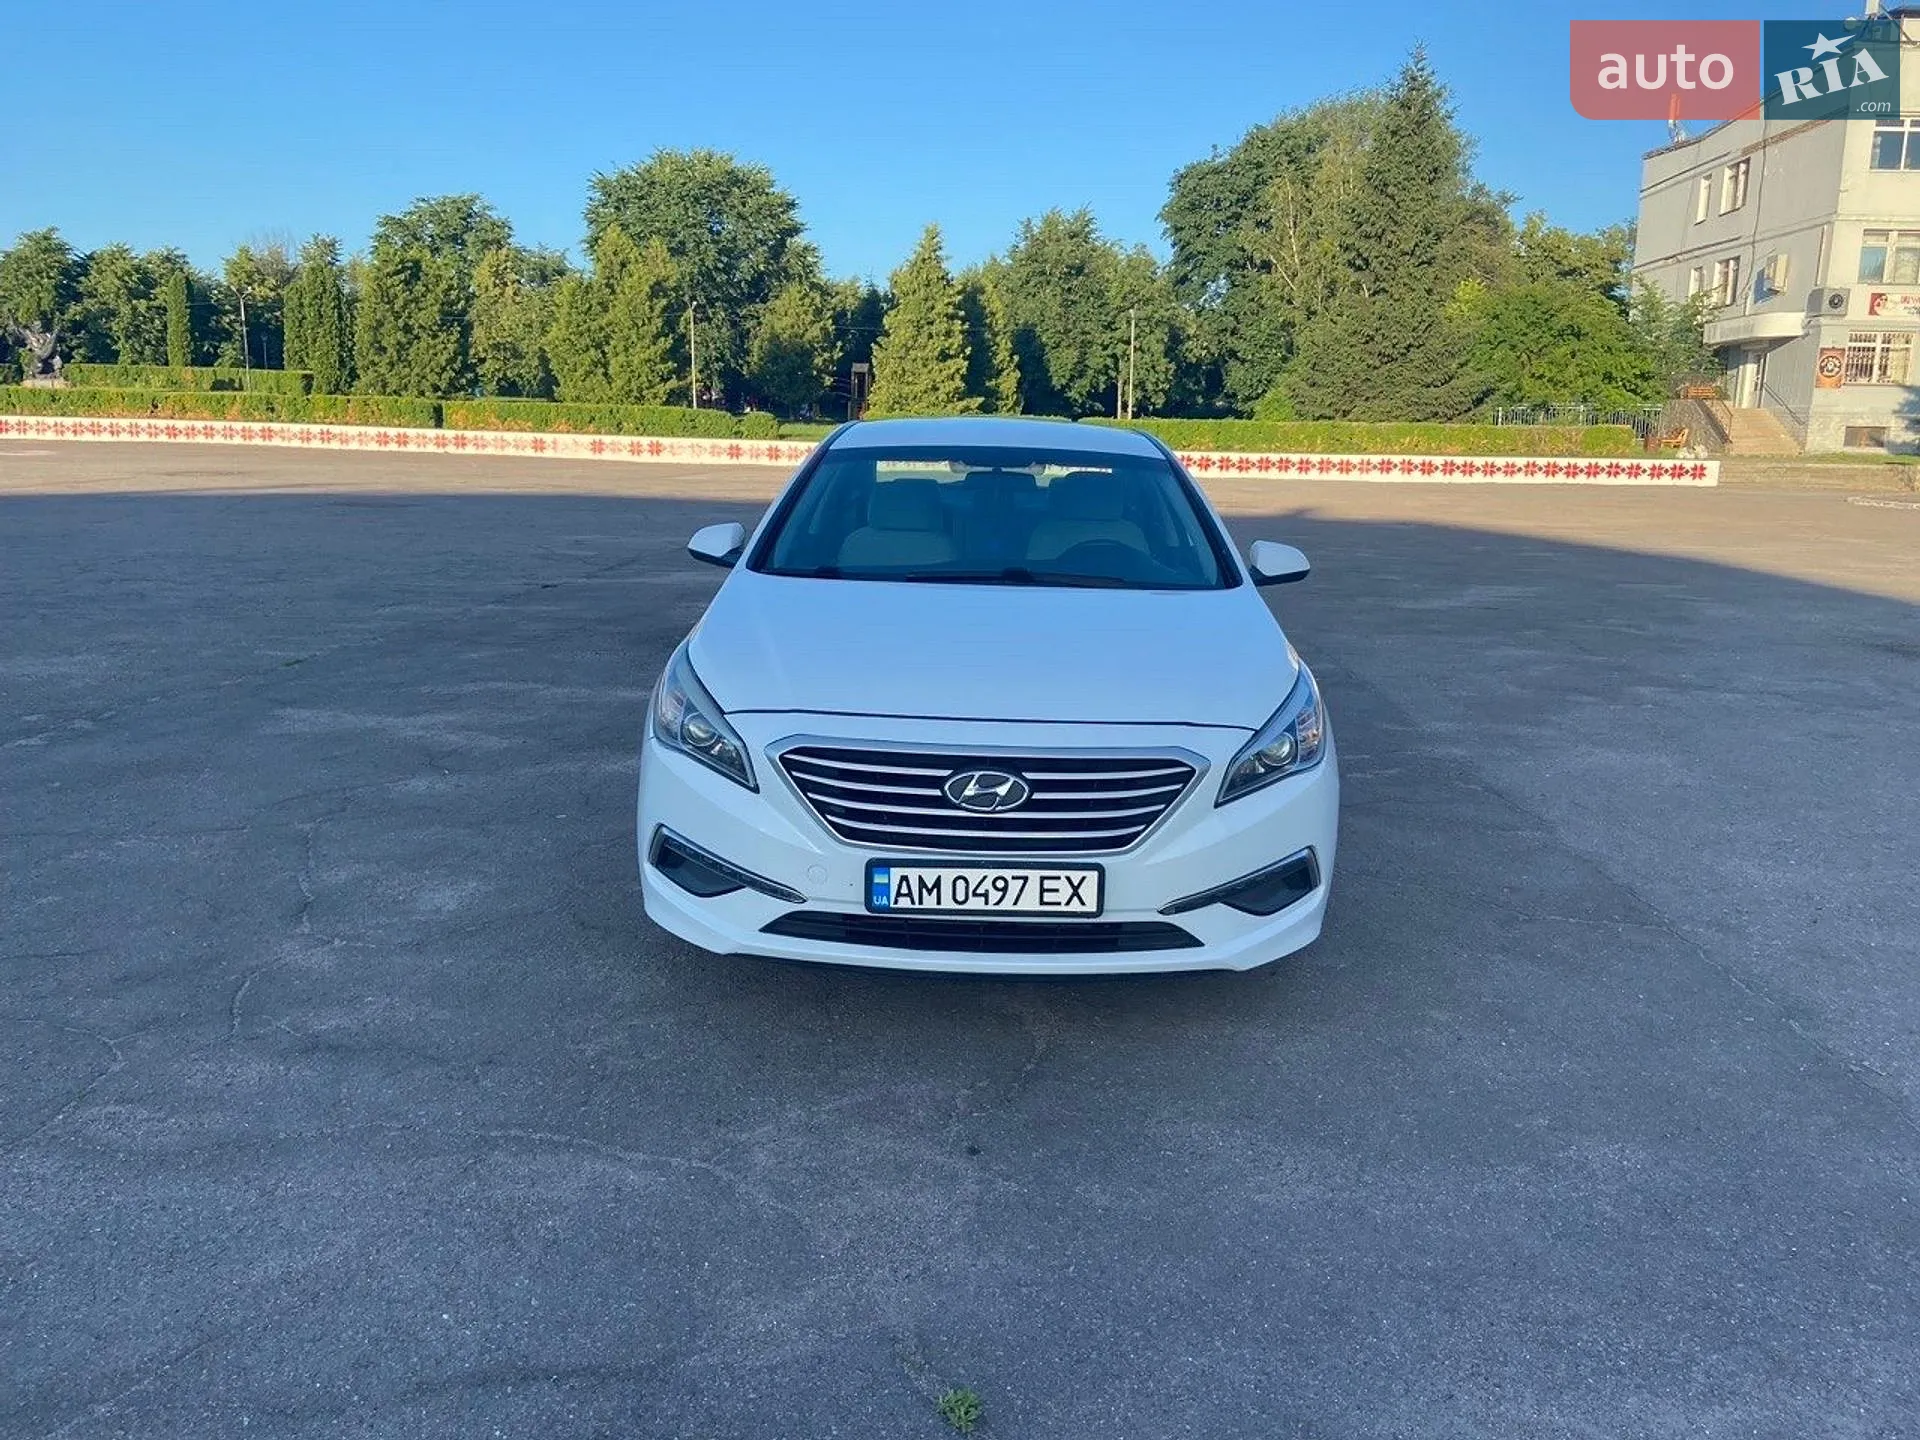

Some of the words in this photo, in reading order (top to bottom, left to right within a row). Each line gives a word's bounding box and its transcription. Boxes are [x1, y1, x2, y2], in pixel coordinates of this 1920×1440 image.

[873, 895, 889, 905] UA
[893, 874, 942, 906] AM
[951, 874, 1029, 906] 0497
[1039, 875, 1087, 906] EX
